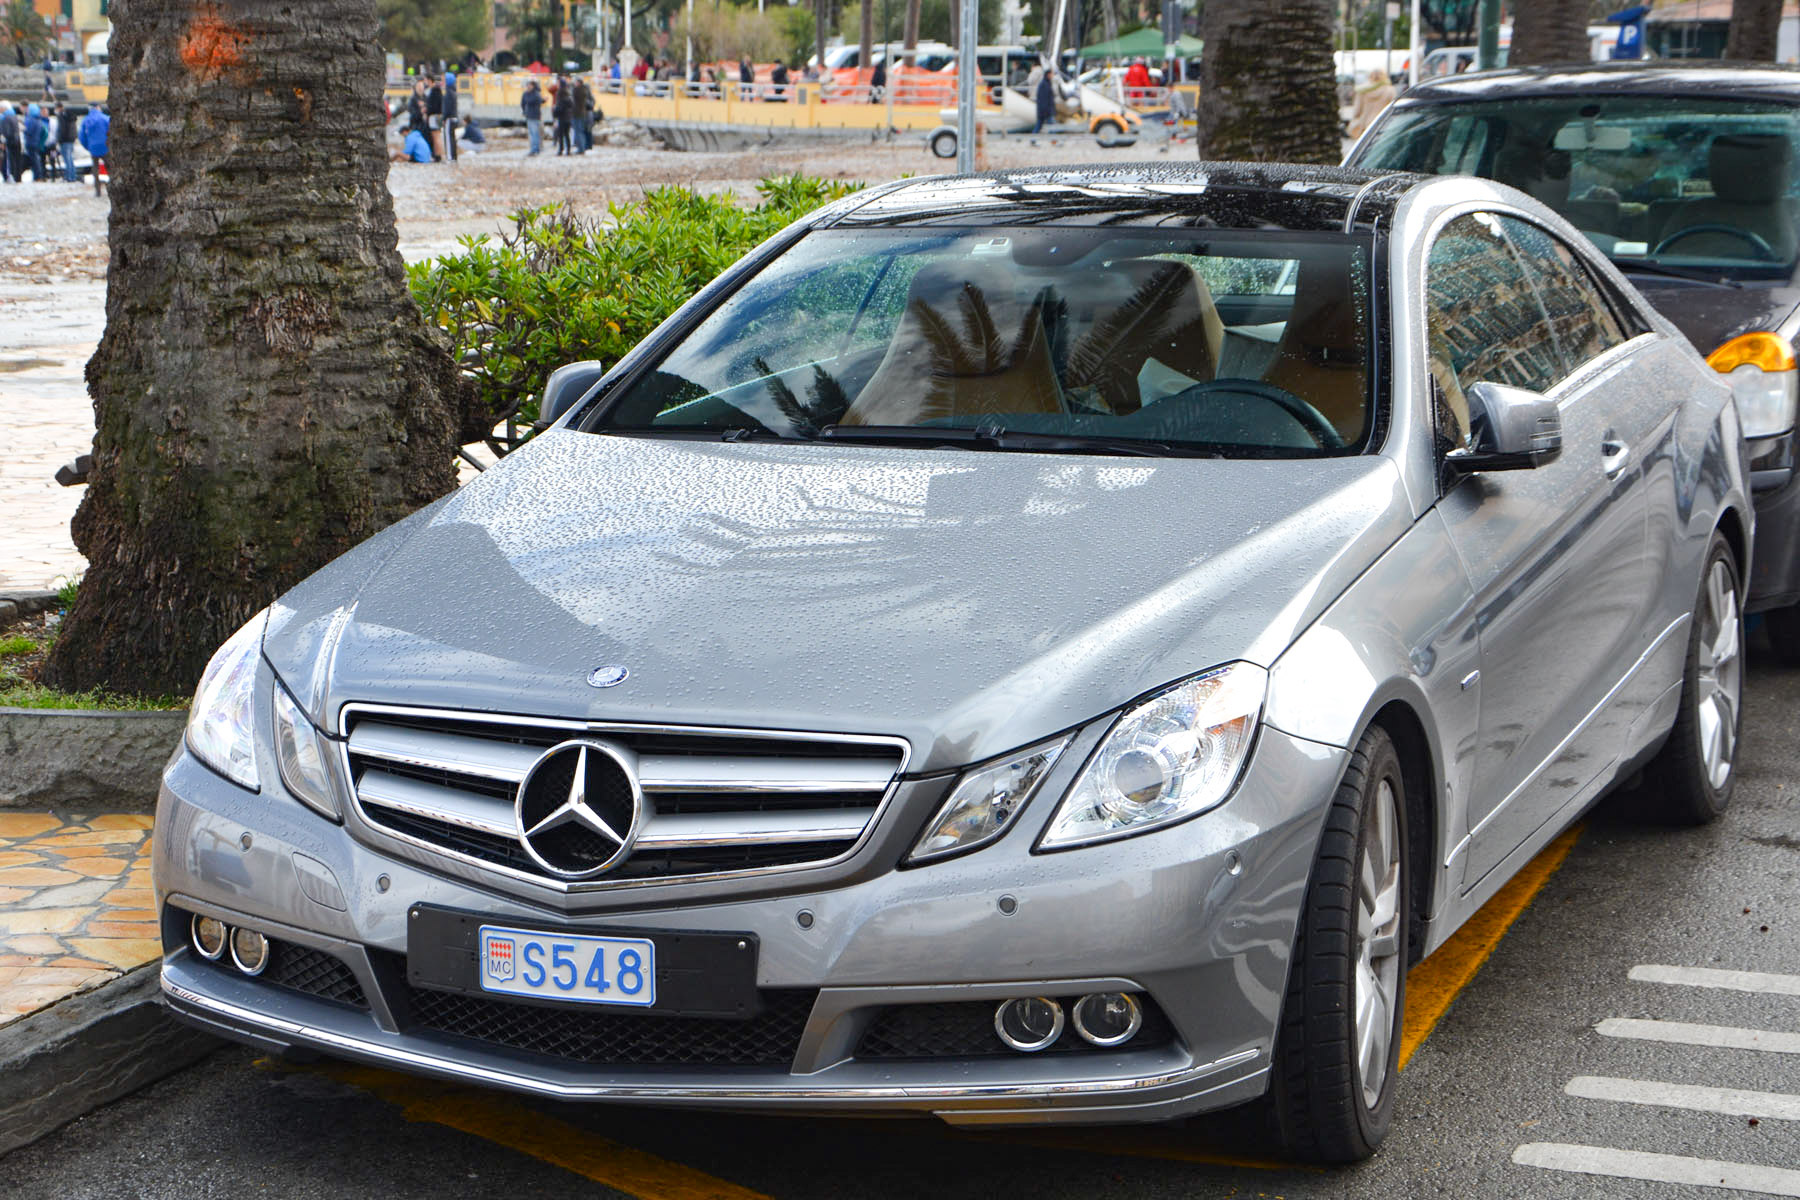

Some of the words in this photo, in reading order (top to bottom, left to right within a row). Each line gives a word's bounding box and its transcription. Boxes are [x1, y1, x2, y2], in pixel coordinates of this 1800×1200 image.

[1623, 25, 1638, 45] P
[491, 959, 512, 975] MC
[522, 941, 643, 995] S548
